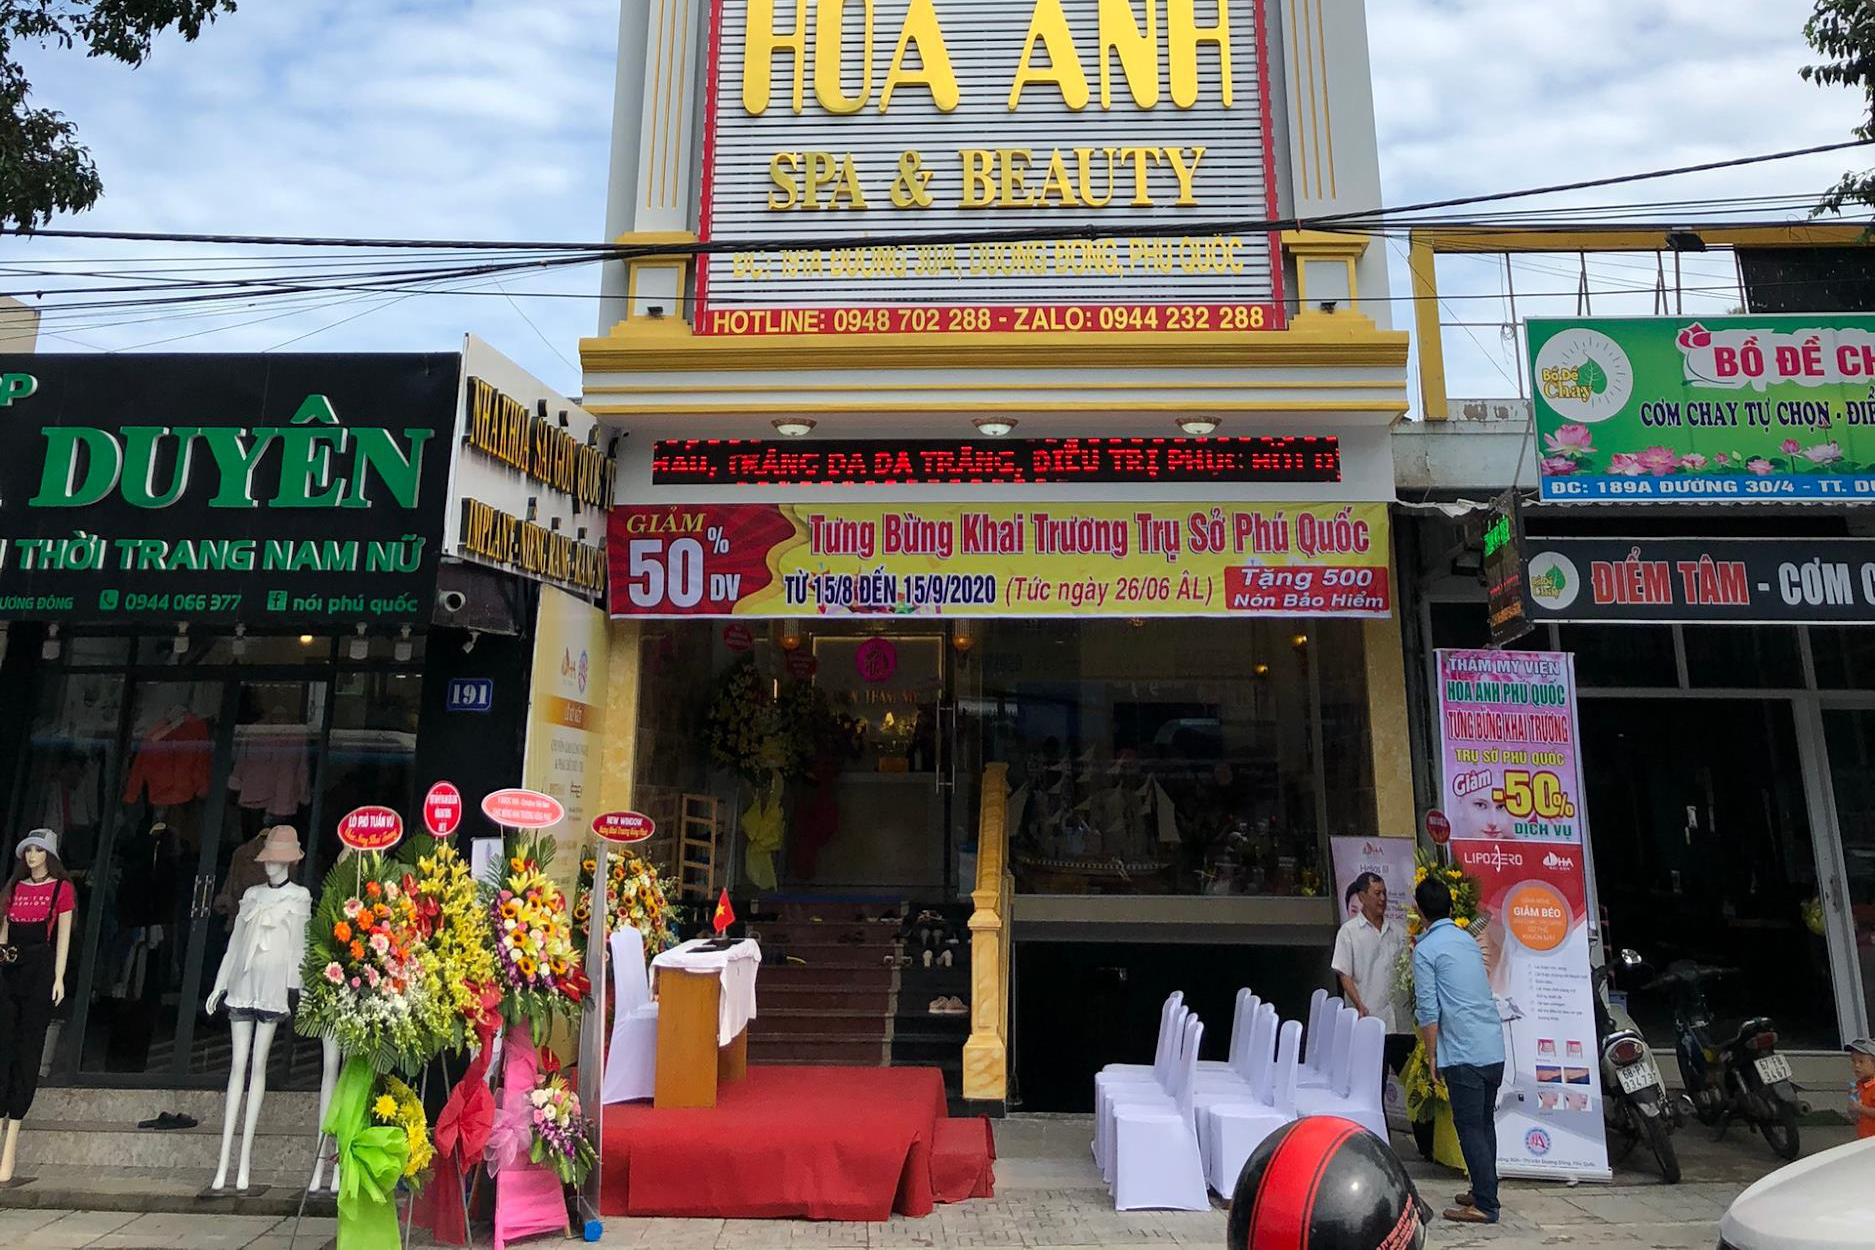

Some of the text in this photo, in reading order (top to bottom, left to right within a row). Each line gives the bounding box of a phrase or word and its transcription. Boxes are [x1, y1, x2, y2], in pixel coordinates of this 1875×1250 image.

[767, 146, 1206, 212] SPA & BEAUTY
[713, 310, 826, 334] HOTLINE:
[833, 309, 890, 332] 0948
[898, 308, 940, 331] 702
[948, 308, 991, 331] 288
[1014, 307, 1093, 331] ZALO:
[1099, 306, 1158, 329] 0944
[1166, 306, 1210, 329] 232
[1219, 306, 1264, 329] 288
[1714, 335, 1764, 377] BỒ
[1776, 335, 1825, 377] ĐỀ
[1543, 381, 1591, 403] Chay
[1641, 398, 1682, 427] CƠM
[1687, 401, 1738, 426] CHAY
[1744, 397, 1771, 432] TỰ
[1777, 401, 1831, 432] CHỌN
[28, 394, 434, 508] DUYÊN
[1551, 481, 1588, 495] ĐC:
[1598, 481, 1652, 494] 189A
[1660, 477, 1738, 493] ĐƯỜNG
[1745, 480, 1794, 493] 30/4
[1818, 480, 1847, 493] TT.
[626, 506, 705, 534] GIẢM
[809, 507, 1370, 562] Tưng Bừng Khai Trương Trụ Sở Phú Quốc
[15, 530, 107, 570] THỜI
[114, 539, 256, 570] TRANG
[262, 540, 359, 570] NAM
[365, 534, 426, 572] NỮ
[710, 573, 741, 601] DV
[784, 564, 1213, 607] TỪ 15/8 ĐẾN 15/9/2020 (Tức ngày 26/06 ÂL)
[1241, 568, 1373, 591] Tặng 500
[1591, 546, 1673, 605] ĐIỂM
[1677, 554, 1750, 605] TÂM
[1778, 557, 1854, 605] CƠM
[125, 593, 169, 610] 0944
[173, 594, 206, 611] 066
[209, 594, 242, 611] 377
[328, 593, 364, 614] phú
[370, 591, 418, 615] quốc
[1234, 590, 1384, 609] Nón Bảo Hiểm
[451, 684, 488, 705] 191
[1446, 681, 1472, 702] HOA
[1475, 682, 1500, 703] ANH
[1504, 713, 1528, 741] KHAI
[1514, 905, 1539, 917] GIẢM
